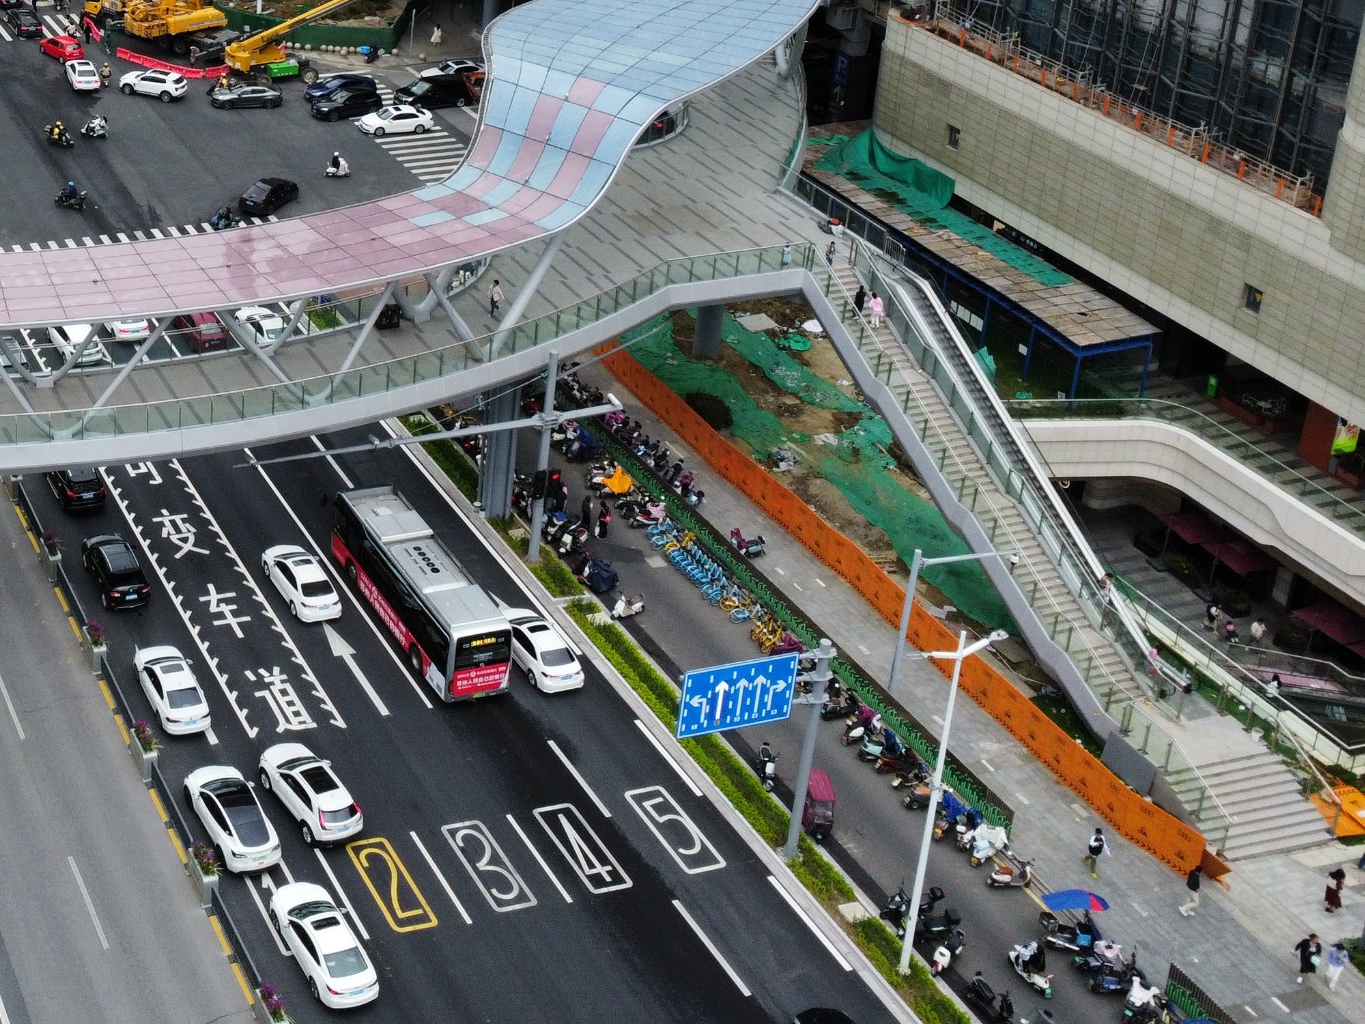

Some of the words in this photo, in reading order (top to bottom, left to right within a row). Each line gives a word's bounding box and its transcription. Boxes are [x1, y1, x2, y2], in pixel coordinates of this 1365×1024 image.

[125, 462, 317, 733] 可变车道
[558, 813, 613, 882] 4
[642, 797, 701, 855] 5
[359, 847, 423, 919] 2
[456, 828, 520, 900] 3
